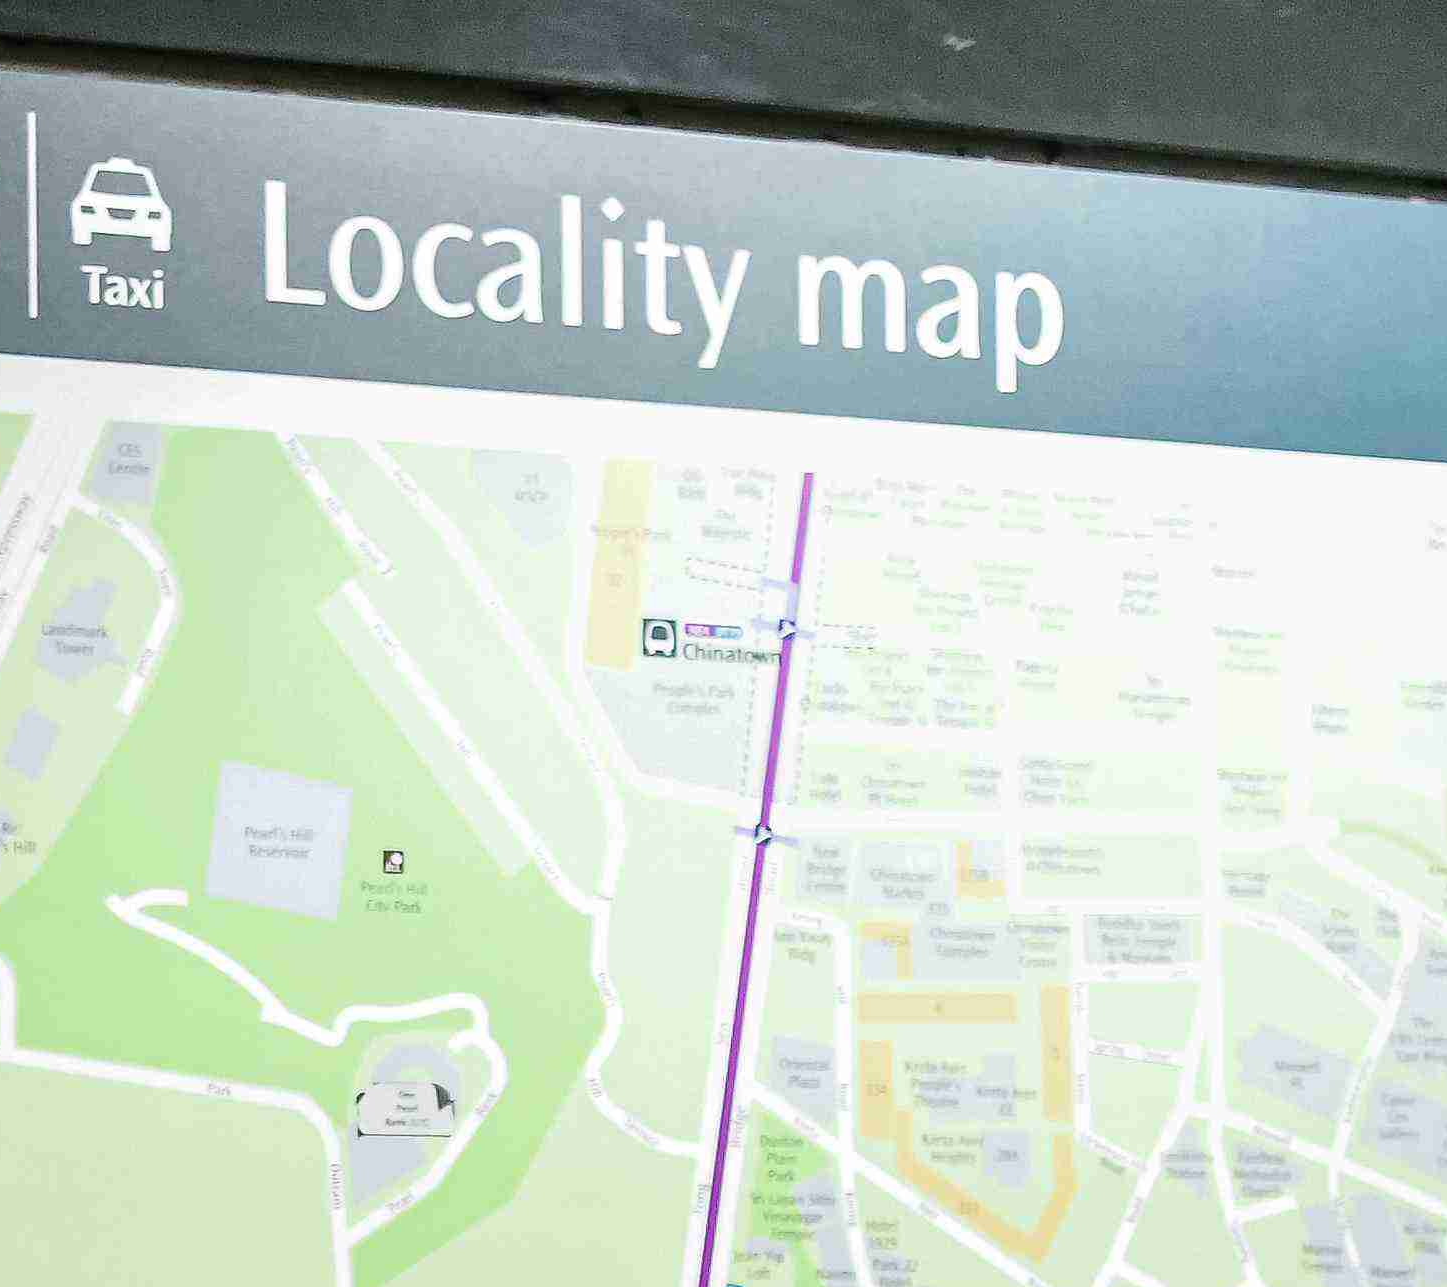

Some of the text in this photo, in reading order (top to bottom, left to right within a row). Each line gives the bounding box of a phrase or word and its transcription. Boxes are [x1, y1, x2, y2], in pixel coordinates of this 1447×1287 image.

[81, 265, 165, 310] Taxi
[263, 180, 1064, 393] Locality map
[683, 644, 782, 667] Chinatown
